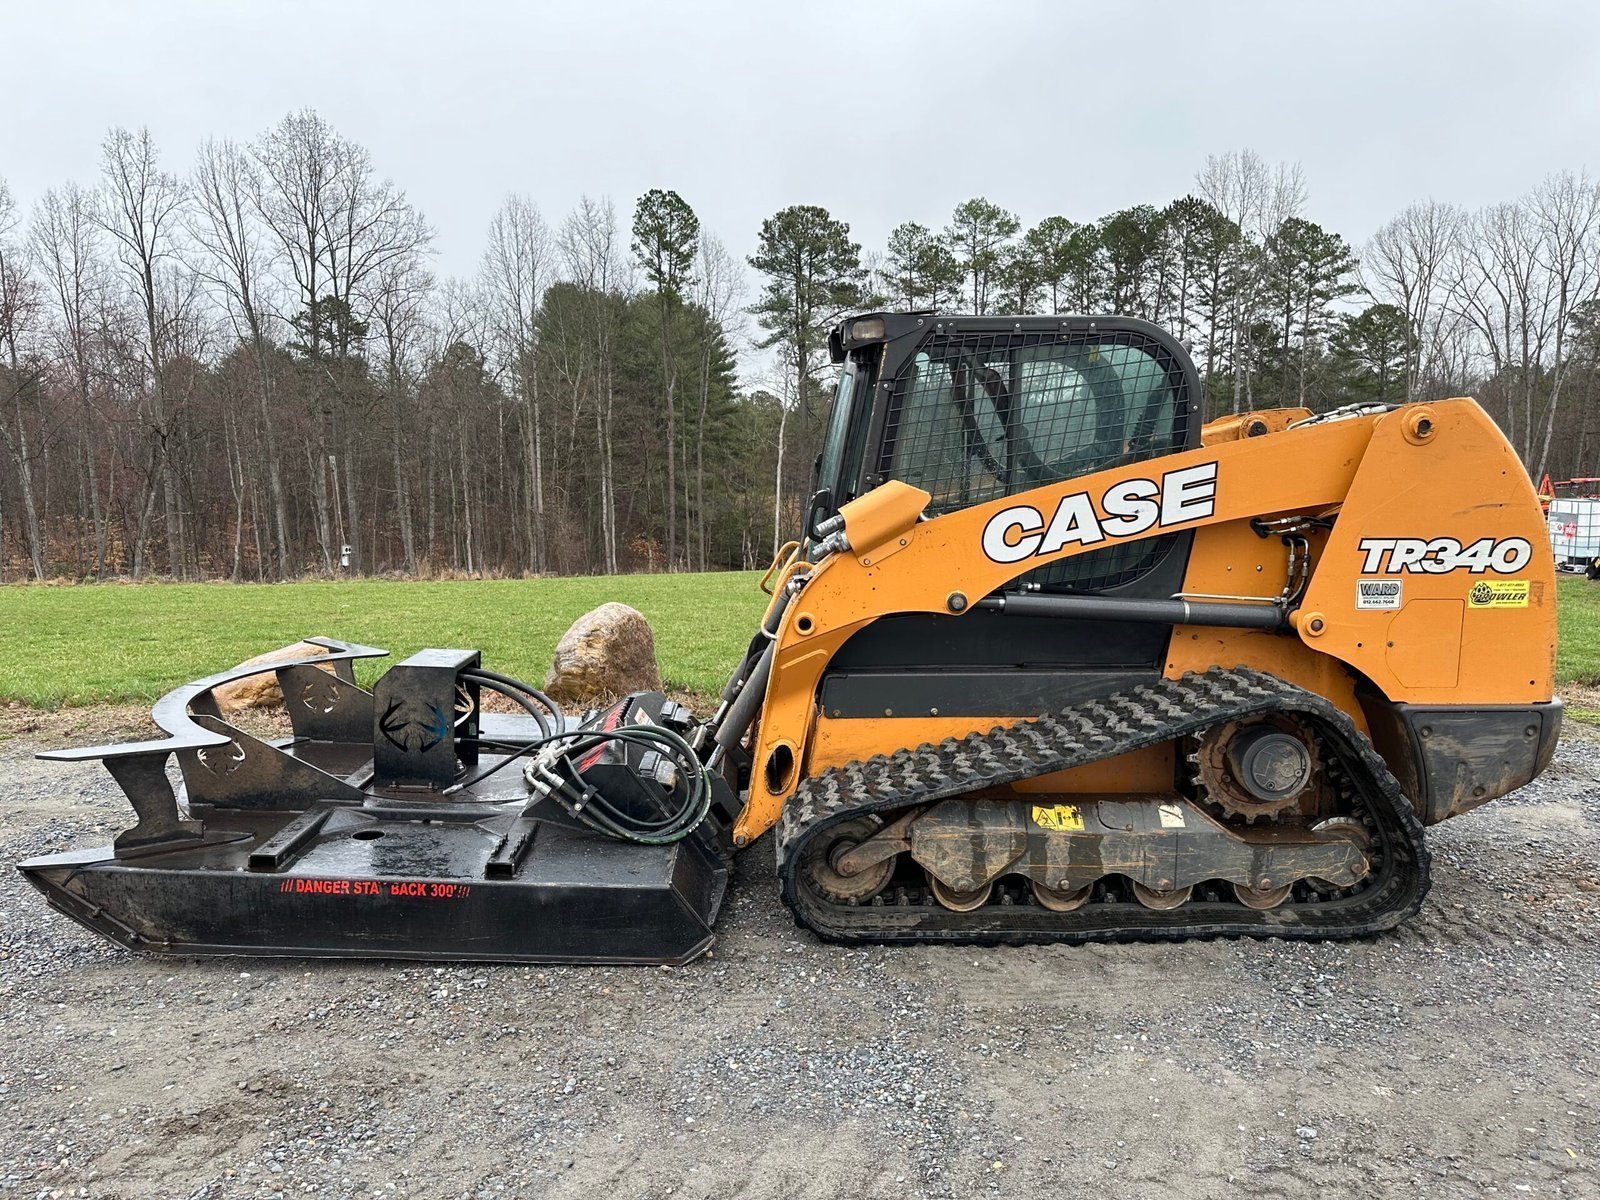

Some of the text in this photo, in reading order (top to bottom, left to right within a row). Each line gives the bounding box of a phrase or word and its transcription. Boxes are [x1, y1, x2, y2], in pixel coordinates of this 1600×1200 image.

[982, 460, 1219, 563] CASE
[1357, 537, 1533, 574] TR340
[1360, 583, 1400, 596] WARD
[1474, 592, 1527, 602] PROWLER
[296, 879, 350, 894] DANGER
[353, 881, 388, 895] STA
[390, 882, 427, 897] BACK
